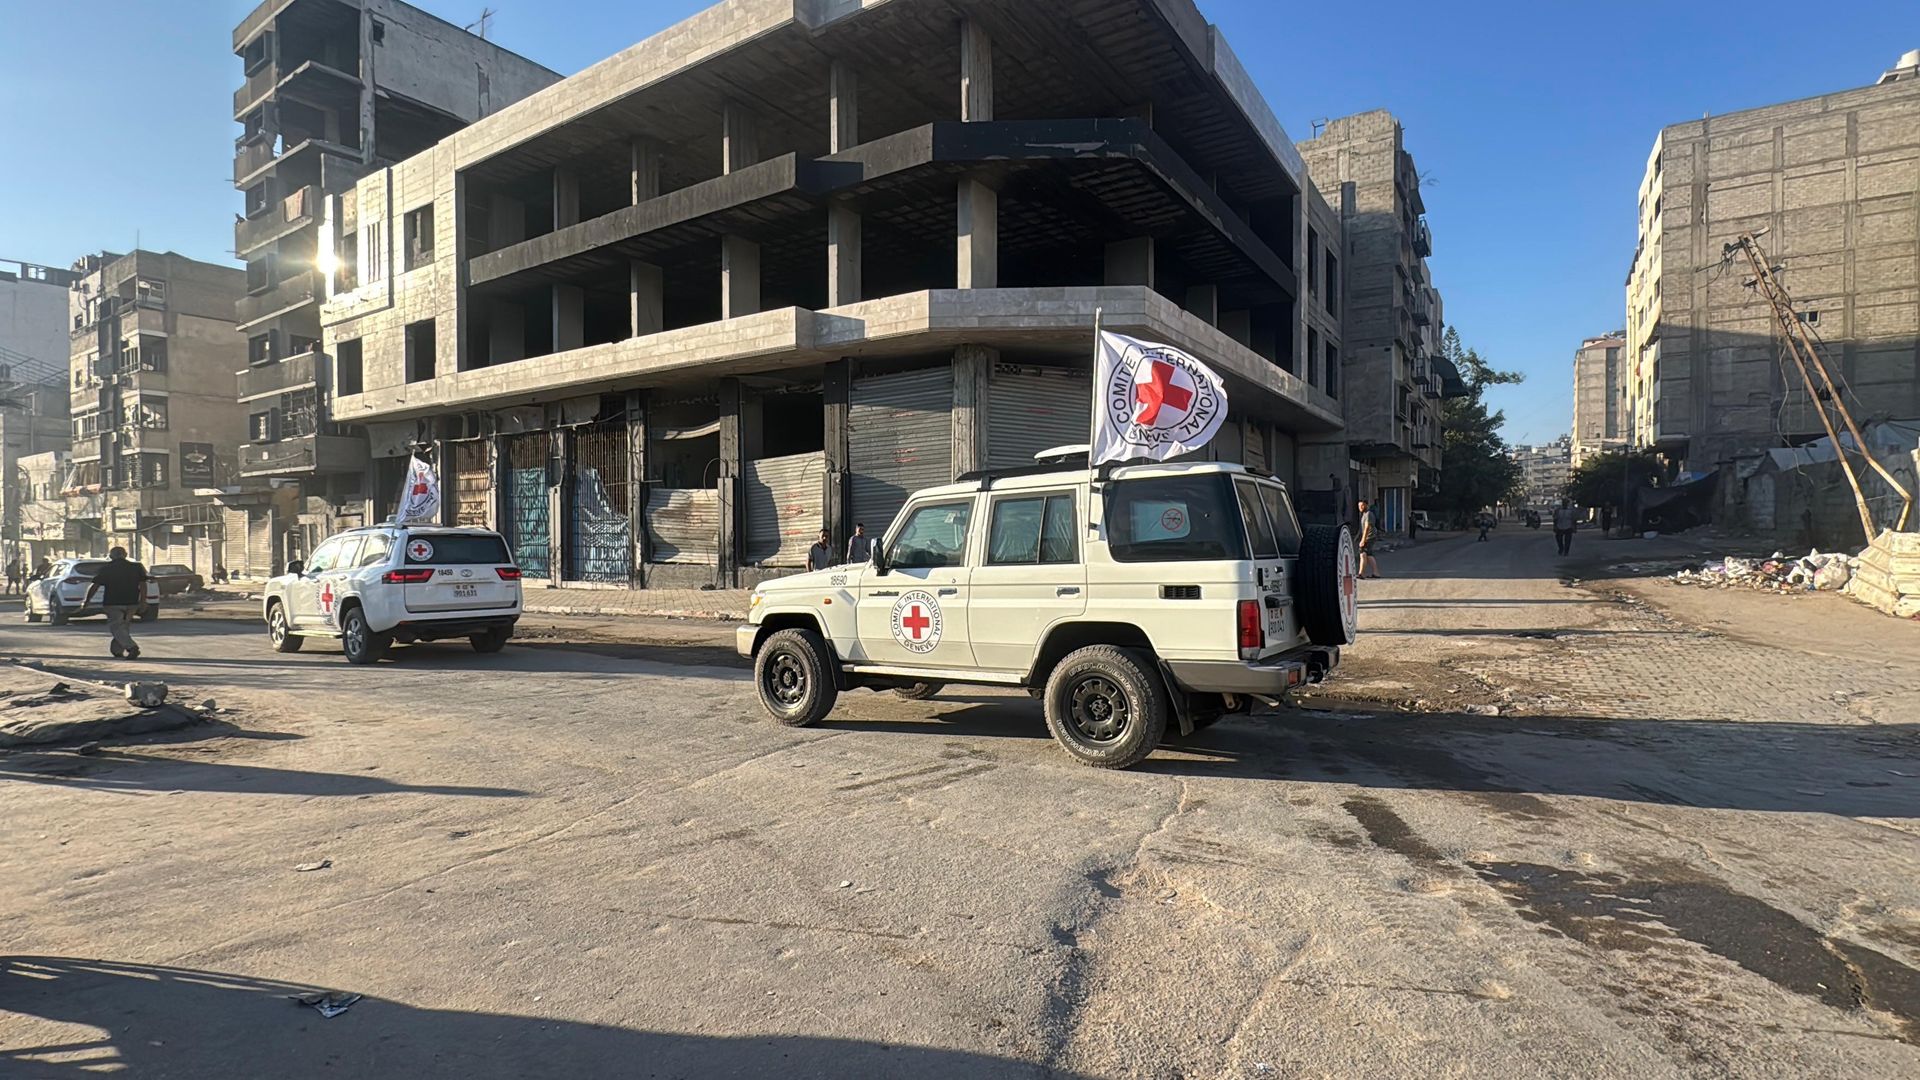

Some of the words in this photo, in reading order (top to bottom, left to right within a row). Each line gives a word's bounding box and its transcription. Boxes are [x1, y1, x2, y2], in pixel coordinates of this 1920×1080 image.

[1113, 355, 1136, 424] COMITE
[1139, 347, 1213, 435] ITERNATIONAL
[893, 602, 904, 637] COMITE
[904, 592, 941, 636] INTERNATIONAL
[903, 640, 934, 652] GENEVE
